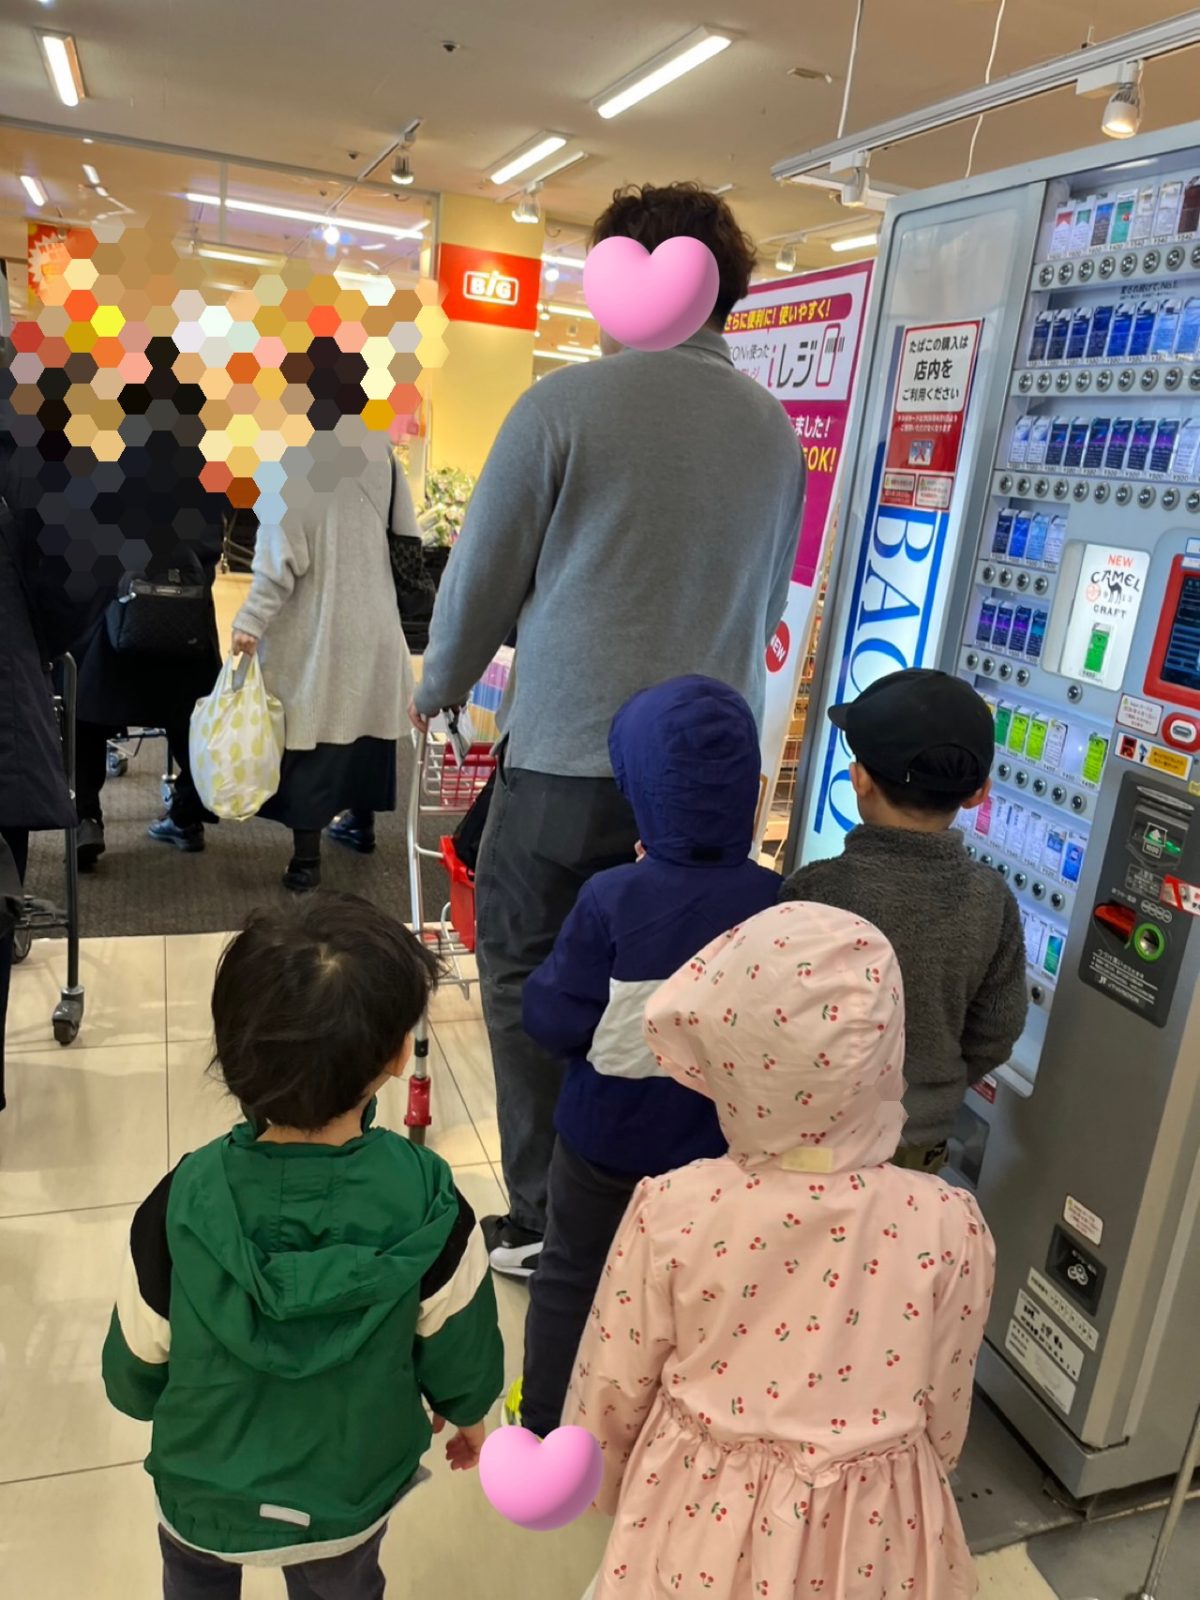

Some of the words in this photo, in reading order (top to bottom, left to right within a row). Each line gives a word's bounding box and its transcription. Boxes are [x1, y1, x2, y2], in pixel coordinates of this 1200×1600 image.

[909, 335, 969, 354] たばこの購入は
[913, 358, 953, 381] 店内を
[902, 387, 960, 402] ご利用ください
[791, 415, 832, 438] ました!
[803, 446, 837, 473] OK!
[1107, 554, 1134, 568] NEW
[1091, 569, 1141, 592] CAMEL
[1093, 603, 1127, 619] CRAFT
